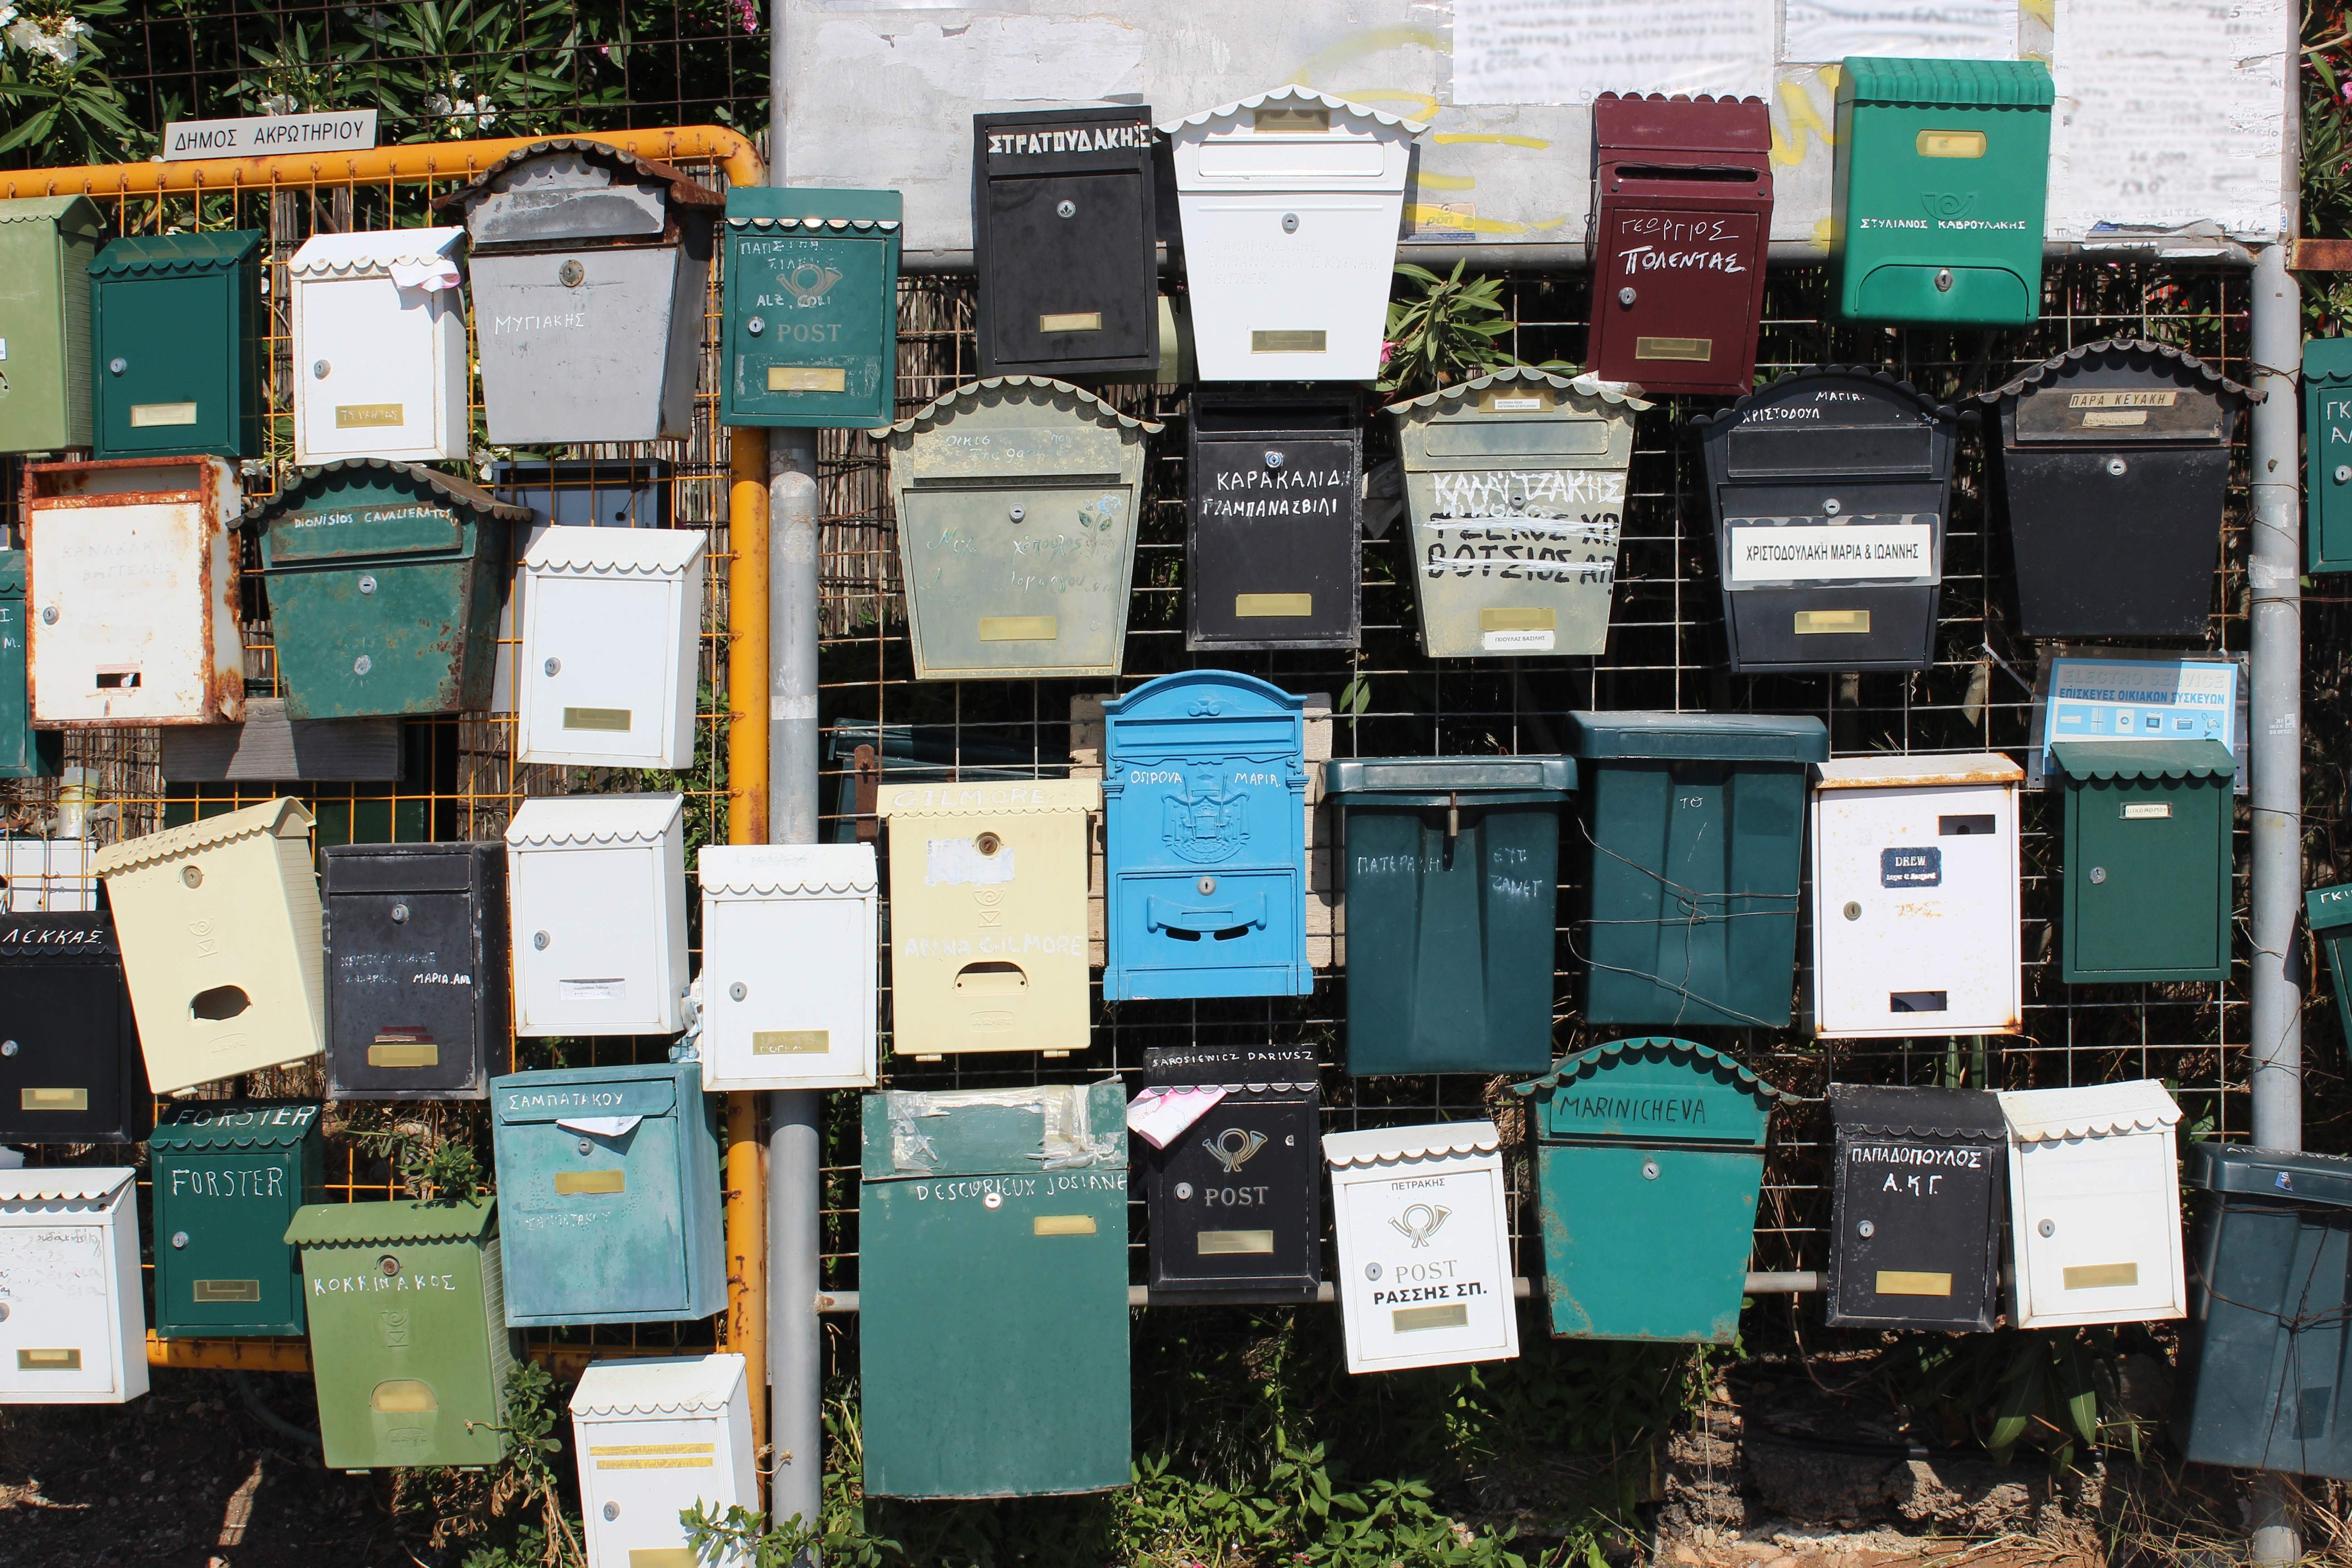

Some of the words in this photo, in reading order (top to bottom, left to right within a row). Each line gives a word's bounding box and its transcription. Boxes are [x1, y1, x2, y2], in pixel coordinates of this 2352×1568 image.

[175, 128, 238, 152] ΔΗΜΟΣ
[254, 121, 365, 145] ΑΚΡΩΤΗΡΙΟΥ
[988, 124, 1151, 154] ΣΤΡΑΤΟΥΔΑΚΗΣ
[1622, 218, 1739, 242] ΓΕΩΡΓΙΟΣ
[1860, 218, 1928, 230] ΣΤΥΛΙΑΝΟΣ
[1938, 219, 2026, 230] ΚΑΒΡΟΥΛΑΚΗΣ
[1618, 245, 1747, 275] ΠΟΛΕΝΤΑΣ
[494, 312, 585, 336] ΜΥΓΙΑΚΗΣ
[778, 323, 842, 342] POST
[2071, 394, 2104, 406] ΠΑΡΑ
[2114, 394, 2166, 405] ΚΕΥΑΚΗ
[1746, 544, 1828, 562] ΧΡΙΣΤΟΔΟΥΛΑΚΗ
[1830, 543, 1862, 561] ΜΑΡΙΑ
[1864, 544, 1872, 560] &
[1874, 543, 1919, 560] ΙΩΑΝΝΗΣ
[2063, 669, 2143, 686] ELECTRO
[2148, 671, 2224, 688] SERVICE
[2059, 687, 2115, 701] ΕΠΙΣΚΕΥΕΣ
[2118, 690, 2168, 703] ΟΙΚΙΑΚΩΝ
[2172, 692, 2225, 705] ΣΥΣΚΕΥΩΝ
[1130, 771, 1183, 785] OSIPOVA
[893, 788, 1044, 807] GILMORE
[1357, 855, 1453, 874] ΠΑΤΕΡΑΚΗ
[1895, 856, 1926, 867] DREW
[1910, 872, 1936, 881] Margaret
[2320, 890, 2352, 904] ΓΚΙ
[979, 933, 1084, 956] GILMORE
[1248, 1051, 1314, 1061] DARIUSZ
[509, 1093, 623, 1110] ΣΑΜΠΑΤΑΚΟΥ
[1559, 1096, 1706, 1124] MARINICHEVA
[172, 1105, 317, 1128] FORSTER
[1852, 1147, 1981, 1169] ΠΑΠΑΔΟΠΟΥΛΟΣ
[171, 1167, 283, 1197] FORSTER
[1046, 1174, 1127, 1196] JOSIANE
[1391, 1177, 1446, 1191] ΠΕΤΡΑΚΗΣ
[1204, 1186, 1269, 1206] POST
[1395, 1259, 1458, 1283] POST
[1373, 1284, 1451, 1305] ΡΑΣΣΗΣ
[1456, 1282, 1488, 1297] ΣΠ.
